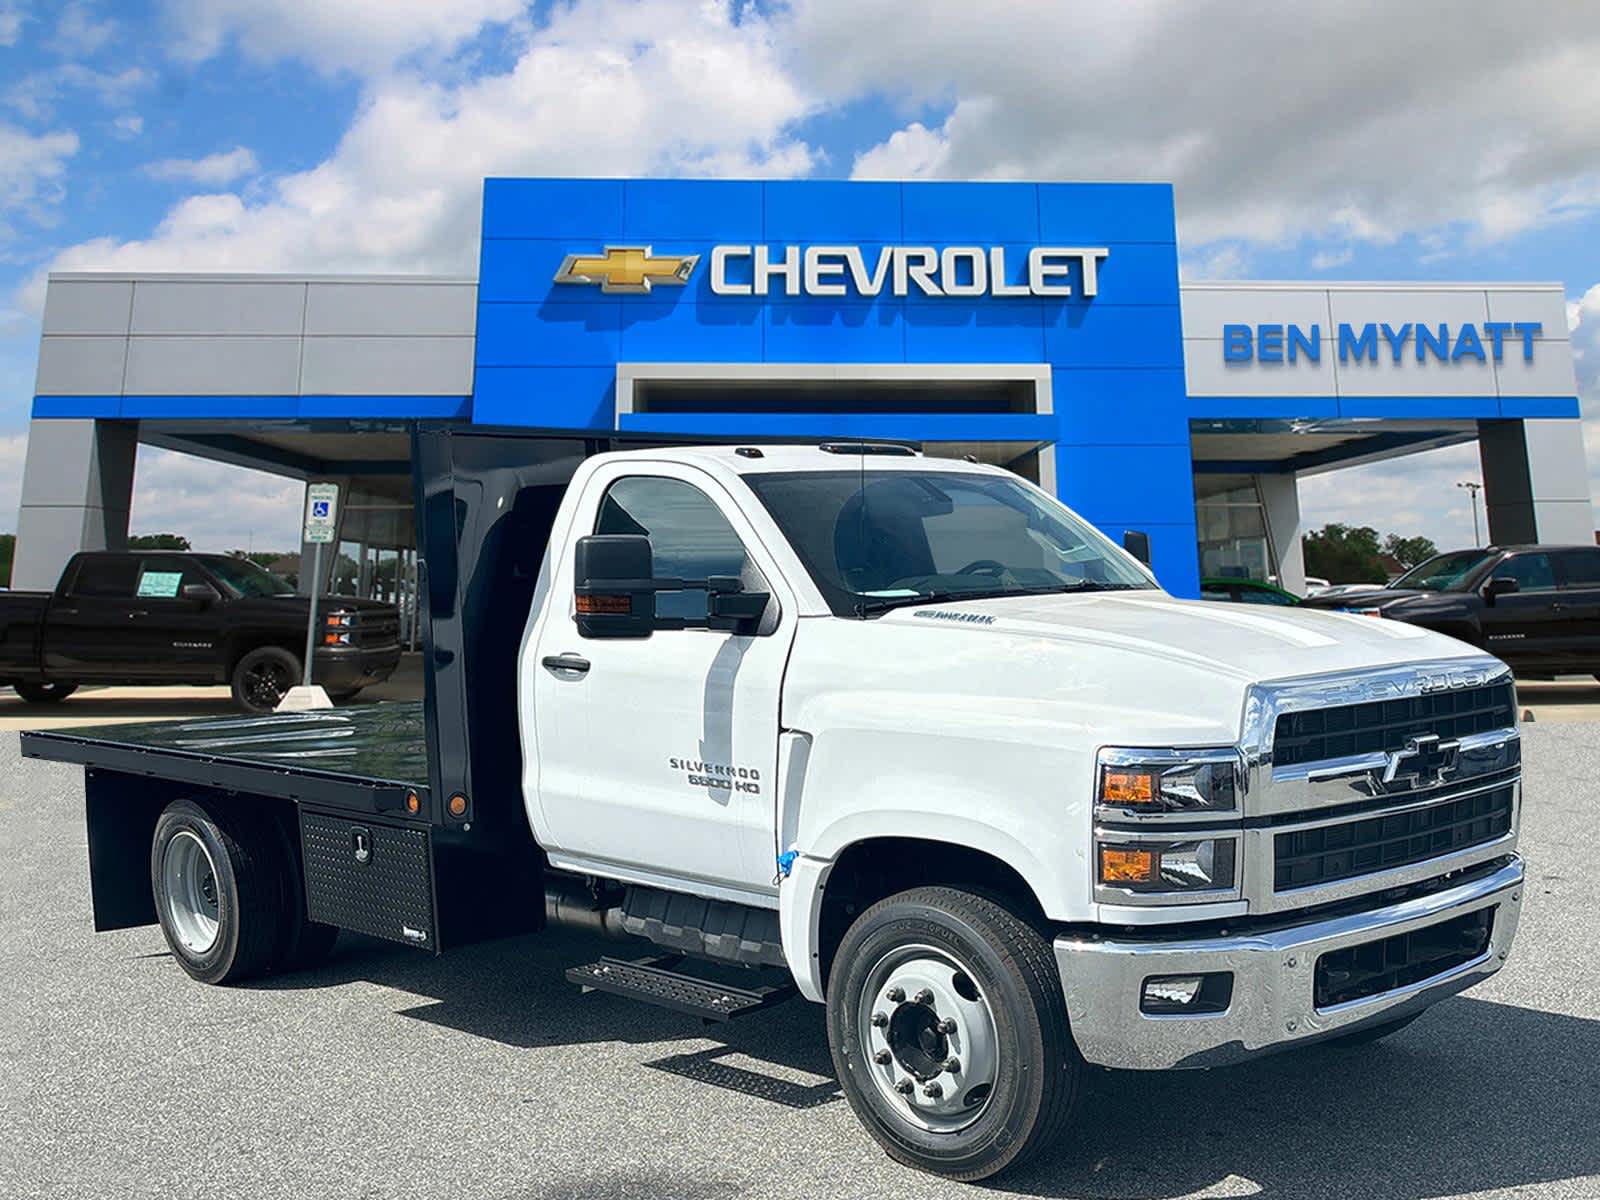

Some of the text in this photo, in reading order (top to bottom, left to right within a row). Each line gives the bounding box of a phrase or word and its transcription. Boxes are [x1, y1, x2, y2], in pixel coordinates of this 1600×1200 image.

[710, 245, 1109, 297] CHEVROLET
[1223, 322, 1542, 363] BEN MYNATT
